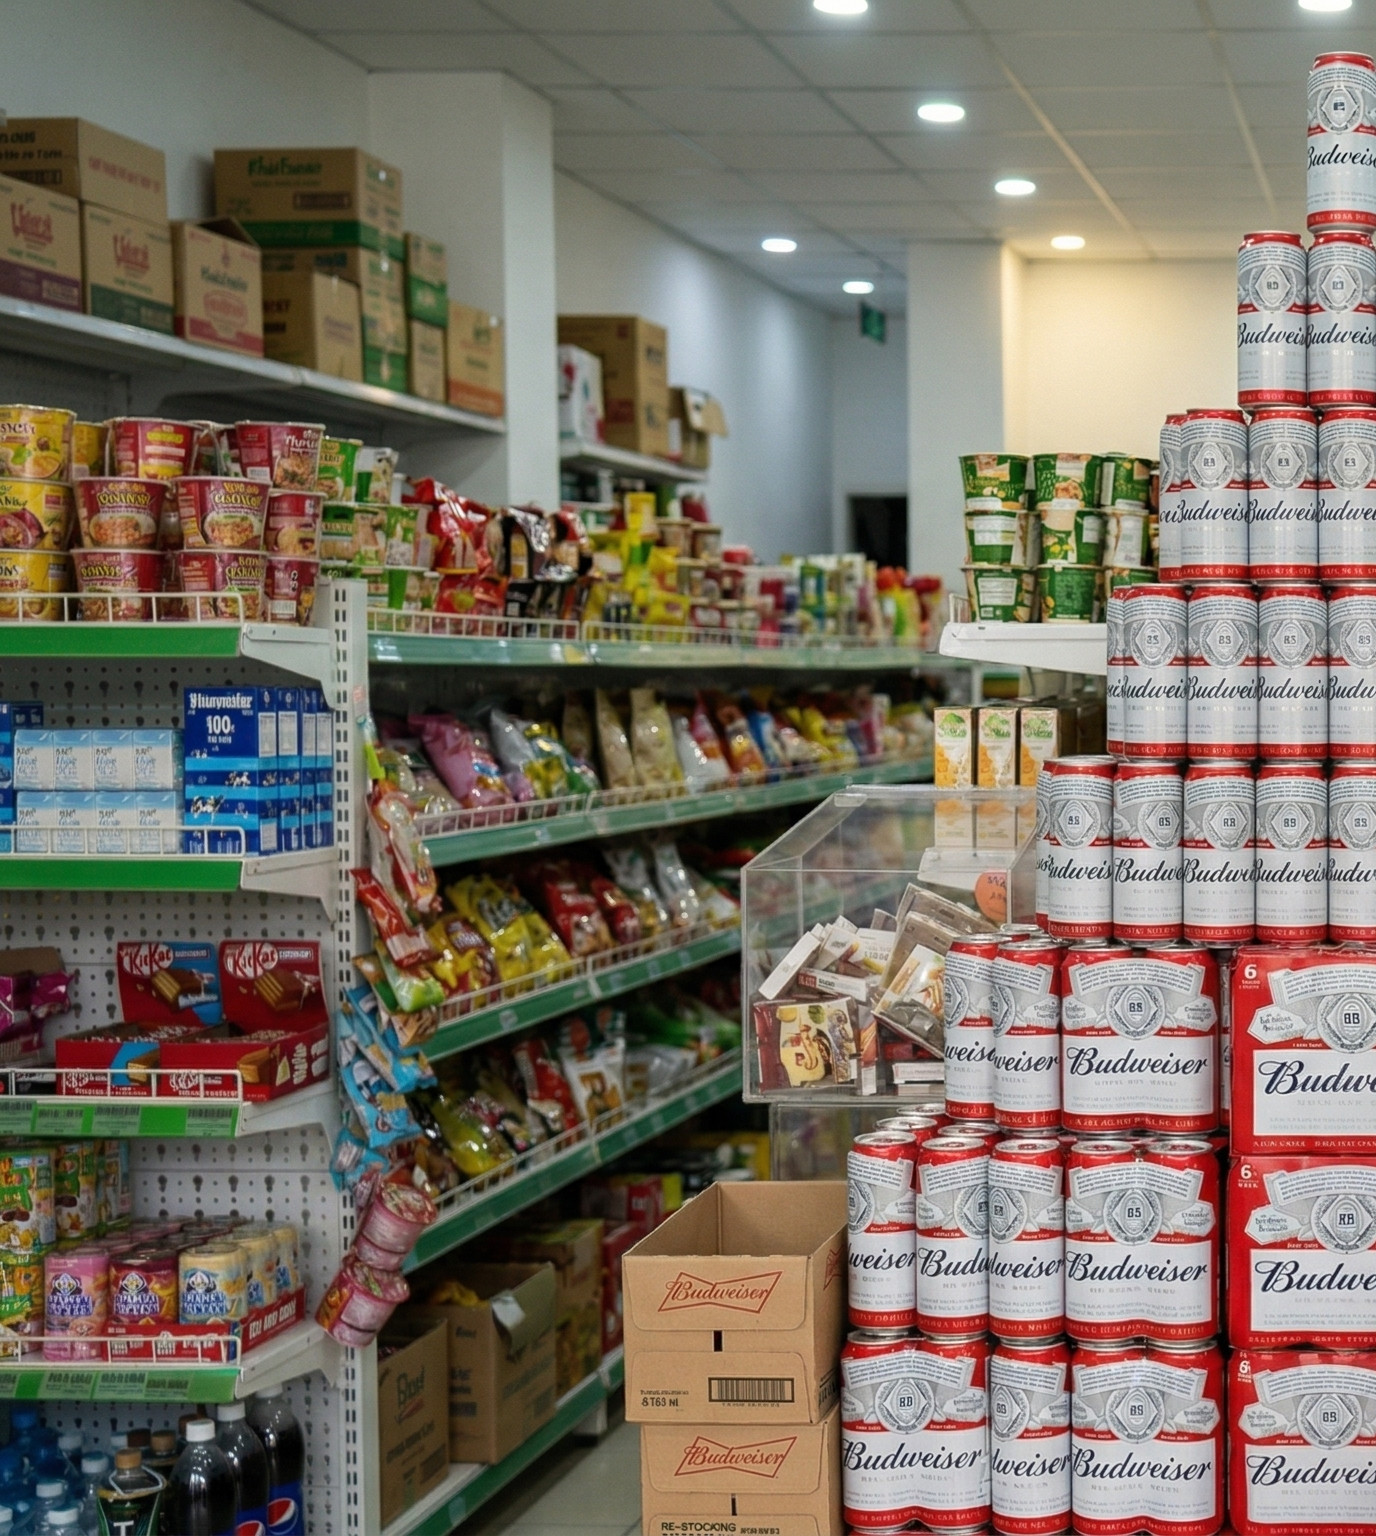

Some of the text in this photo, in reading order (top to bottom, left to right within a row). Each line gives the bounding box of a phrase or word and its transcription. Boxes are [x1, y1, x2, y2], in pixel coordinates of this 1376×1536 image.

[1244, 964, 1257, 979] 6
[1066, 1046, 1210, 1076] Budweiser
[1240, 1164, 1252, 1180] 6
[1065, 1251, 1208, 1283] Budweiser
[667, 1278, 771, 1303] Budweiser
[684, 1446, 786, 1466] Budweiser
[843, 1438, 982, 1471] Budweiser
[1072, 1443, 1212, 1481] Budweiser
